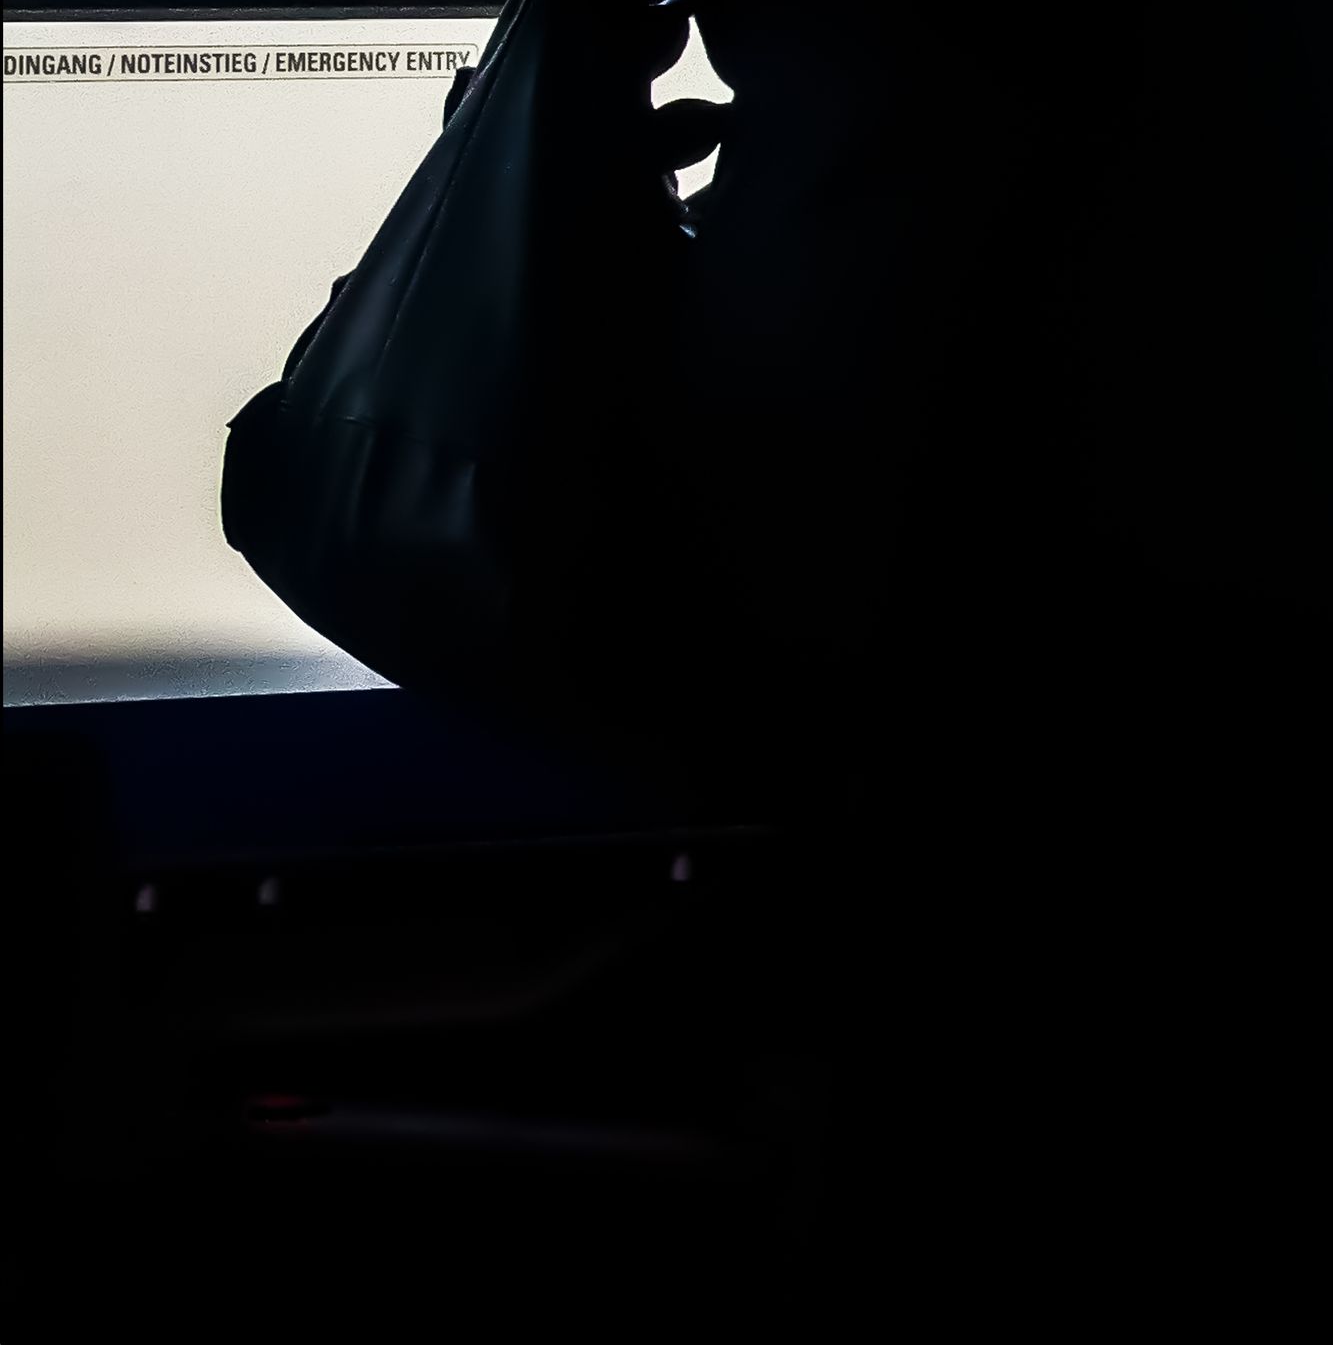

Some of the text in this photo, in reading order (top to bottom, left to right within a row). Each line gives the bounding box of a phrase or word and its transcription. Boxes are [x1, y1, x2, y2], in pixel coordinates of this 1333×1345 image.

[4, 50, 470, 76] DINGANG / NOTEINSTIEG / EMERGENCY ENTRY
